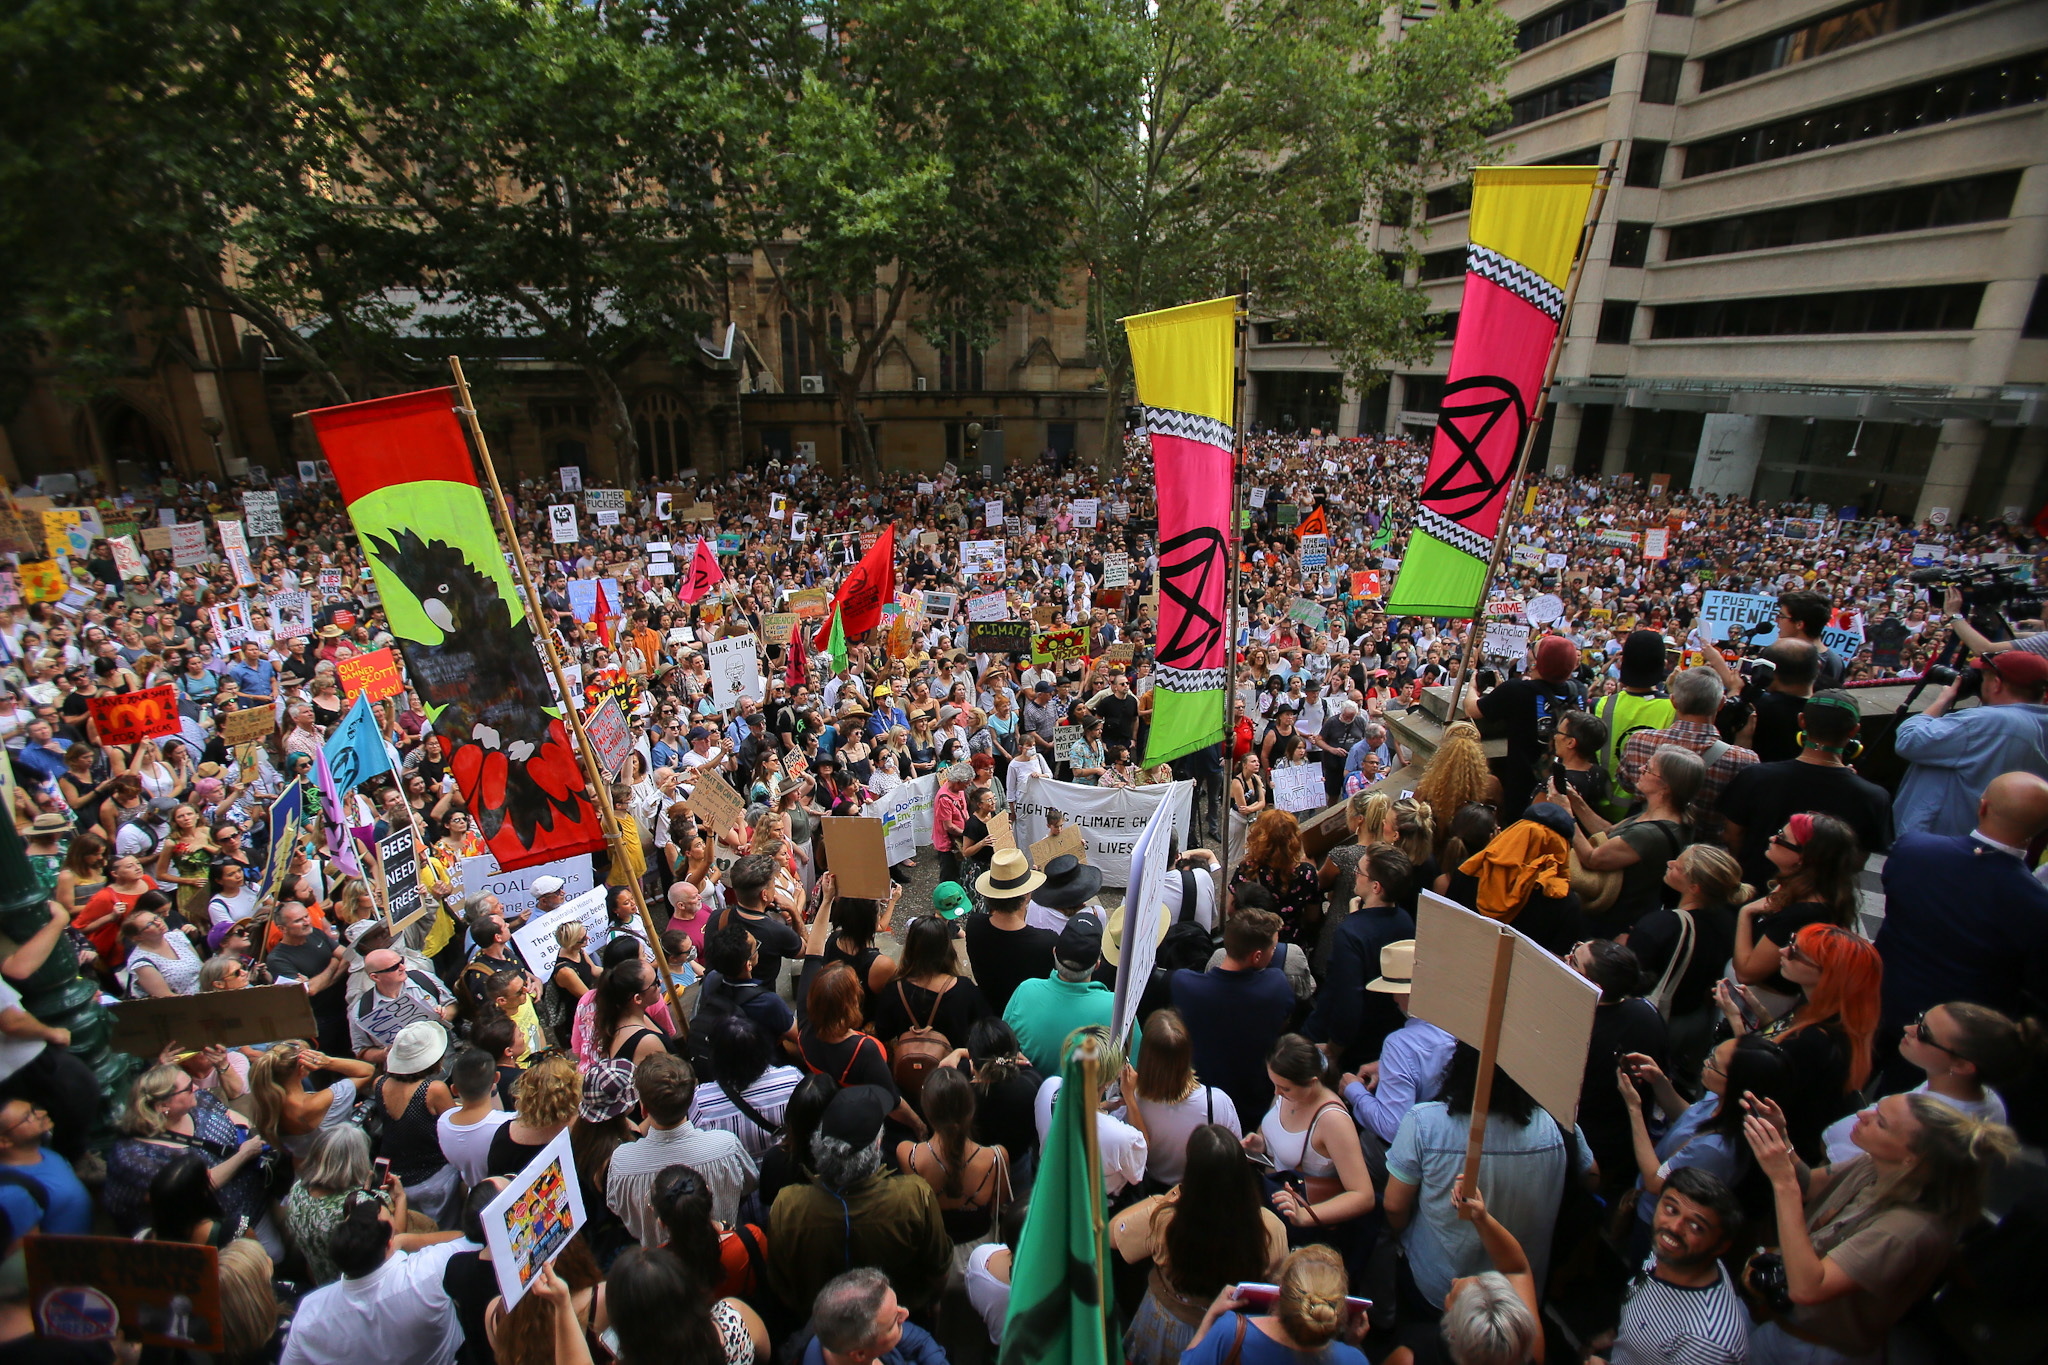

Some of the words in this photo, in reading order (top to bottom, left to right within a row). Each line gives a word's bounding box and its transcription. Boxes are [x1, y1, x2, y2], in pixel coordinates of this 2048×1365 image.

[586, 499, 625, 508] FUCKERS
[270, 591, 309, 601] DISRESPECT
[1713, 595, 1753, 607] TRUST
[1757, 600, 1780, 611] THE
[1489, 602, 1524, 614] CRIME
[1705, 606, 1780, 624] SCIENCE
[977, 623, 1029, 638] CLIMATE
[1486, 621, 1528, 638] Extinction
[710, 643, 729, 656] LIAR
[735, 638, 754, 651] LIAR
[1051, 646, 1088, 660] VISION
[1482, 640, 1525, 658] Bushfire
[338, 659, 361, 675] OUT
[341, 666, 375, 682] DAMNED
[360, 661, 398, 686] SCOTT!
[126, 693, 150, 705] YOUR
[150, 688, 172, 699] SHIT
[373, 691, 379, 699] I
[380, 679, 401, 697] SAY!
[1054, 726, 1072, 738] MAYBE
[1054, 734, 1067, 744] WAS
[789, 759, 807, 778] NOW
[1273, 764, 1314, 780] CLIMATE
[701, 769, 716, 786] WHAT
[722, 789, 732, 802] CAN
[1279, 772, 1322, 790] DENIAL
[1275, 784, 1317, 804] CRIMINAL
[1277, 793, 1326, 812] NEGLIGENCE
[1074, 815, 1126, 828] CLIMATE
[381, 833, 413, 861] BEES
[1098, 842, 1134, 855] LIVES
[385, 859, 417, 888] NEED
[388, 884, 420, 913] TREES
[542, 920, 550, 929] In
[550, 906, 578, 925] Australia's
[576, 896, 594, 911] History
[589, 902, 606, 916] been
[595, 917, 605, 927] for
[588, 937, 596, 945] to
